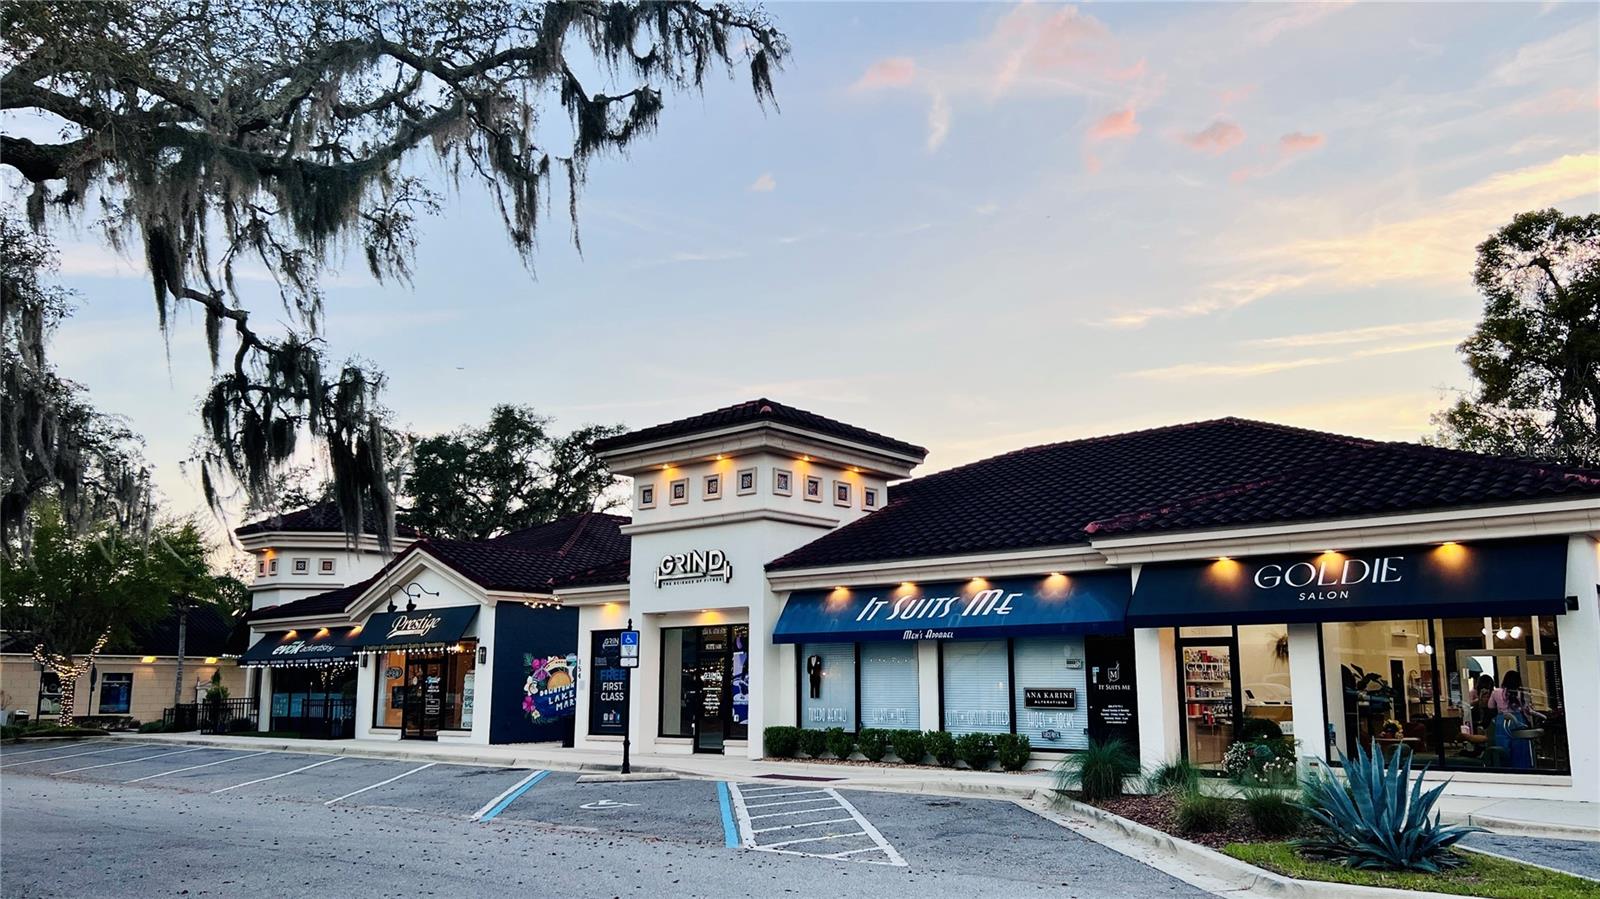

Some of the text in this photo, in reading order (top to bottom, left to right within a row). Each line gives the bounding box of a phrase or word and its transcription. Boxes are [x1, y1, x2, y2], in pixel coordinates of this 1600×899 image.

[660, 550, 725, 575] GRIND
[1254, 556, 1404, 589] GOLDIE
[1299, 590, 1349, 601] SALON
[856, 589, 1023, 621] IT SUITS ME
[386, 613, 441, 639] Prestige
[903, 629, 954, 640] MEN'S APPAREL
[600, 669, 626, 680] FREE
[602, 682, 623, 691] FIRST
[548, 690, 574, 705] LAKE
[600, 692, 624, 701] CLASS
[1043, 691, 1073, 699] KARINE
[556, 698, 577, 711] MAR
